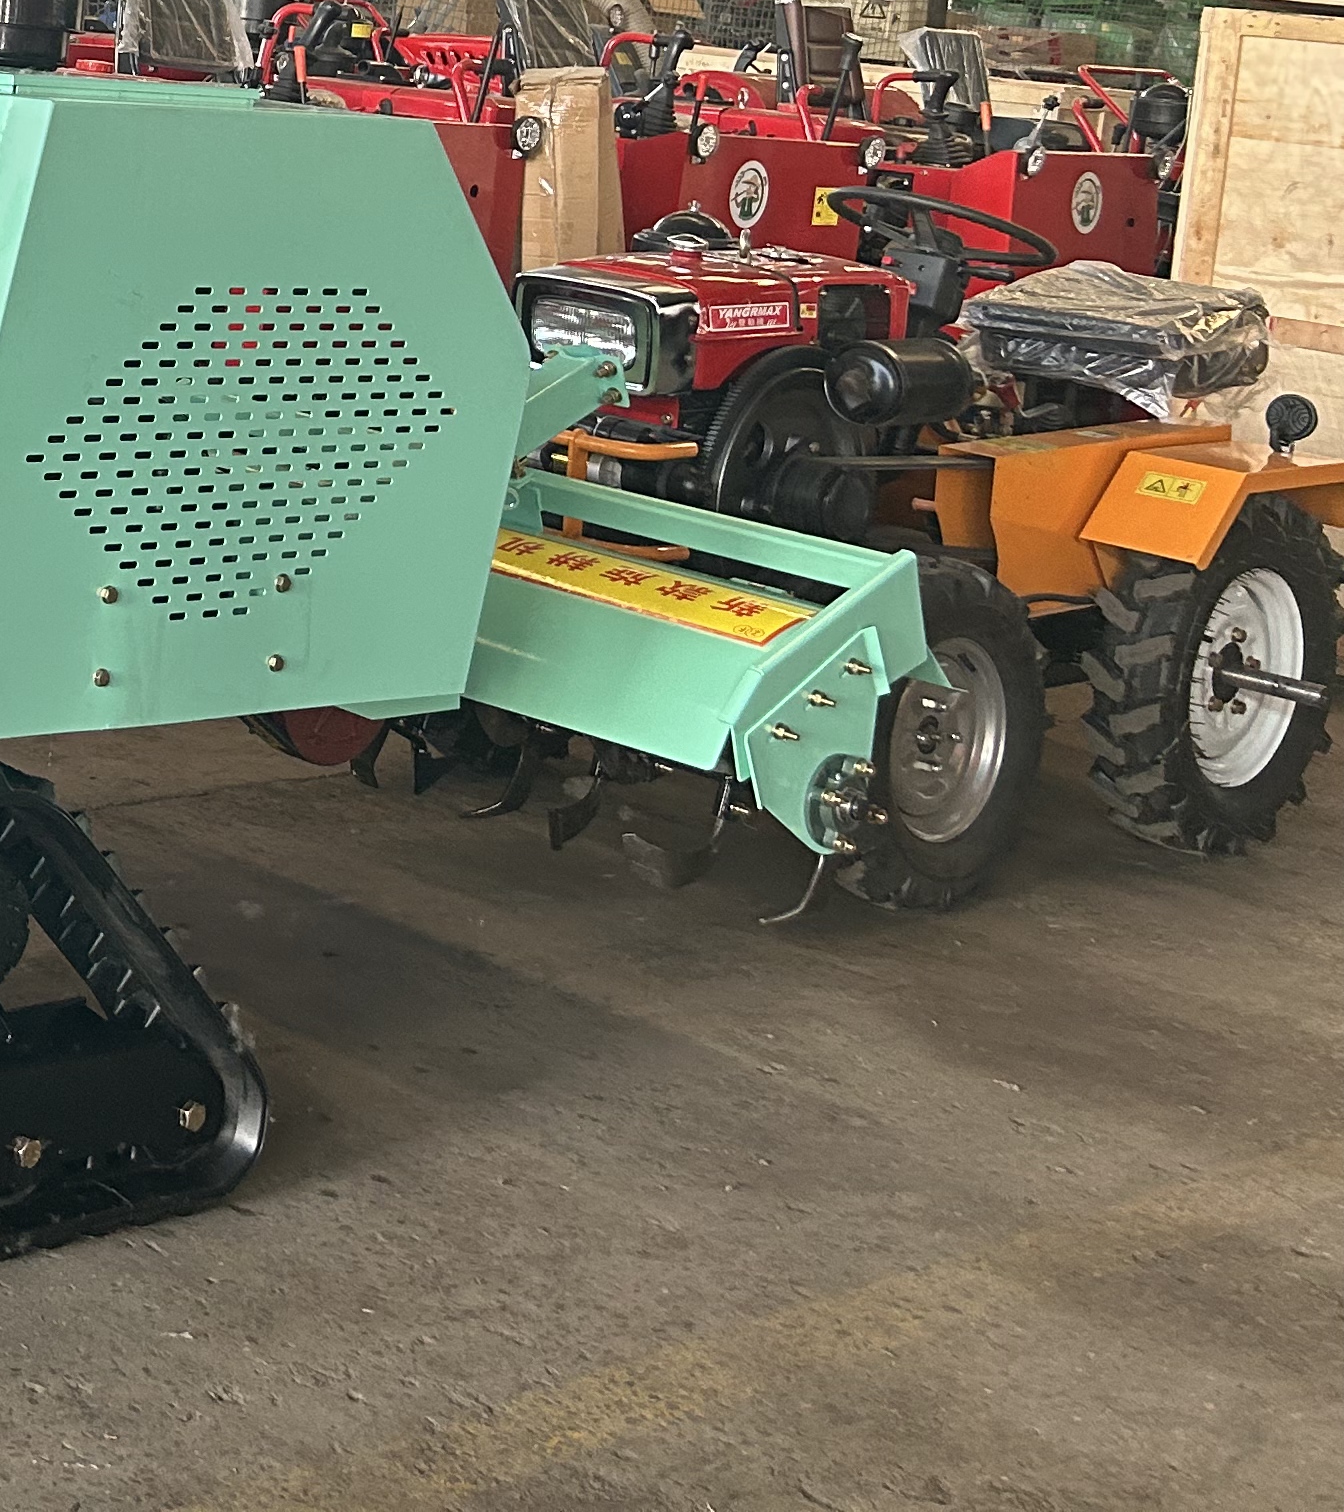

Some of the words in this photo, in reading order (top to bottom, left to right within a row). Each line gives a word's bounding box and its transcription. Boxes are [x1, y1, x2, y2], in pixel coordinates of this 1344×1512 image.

[496, 536, 773, 618] 新款旋耕机
